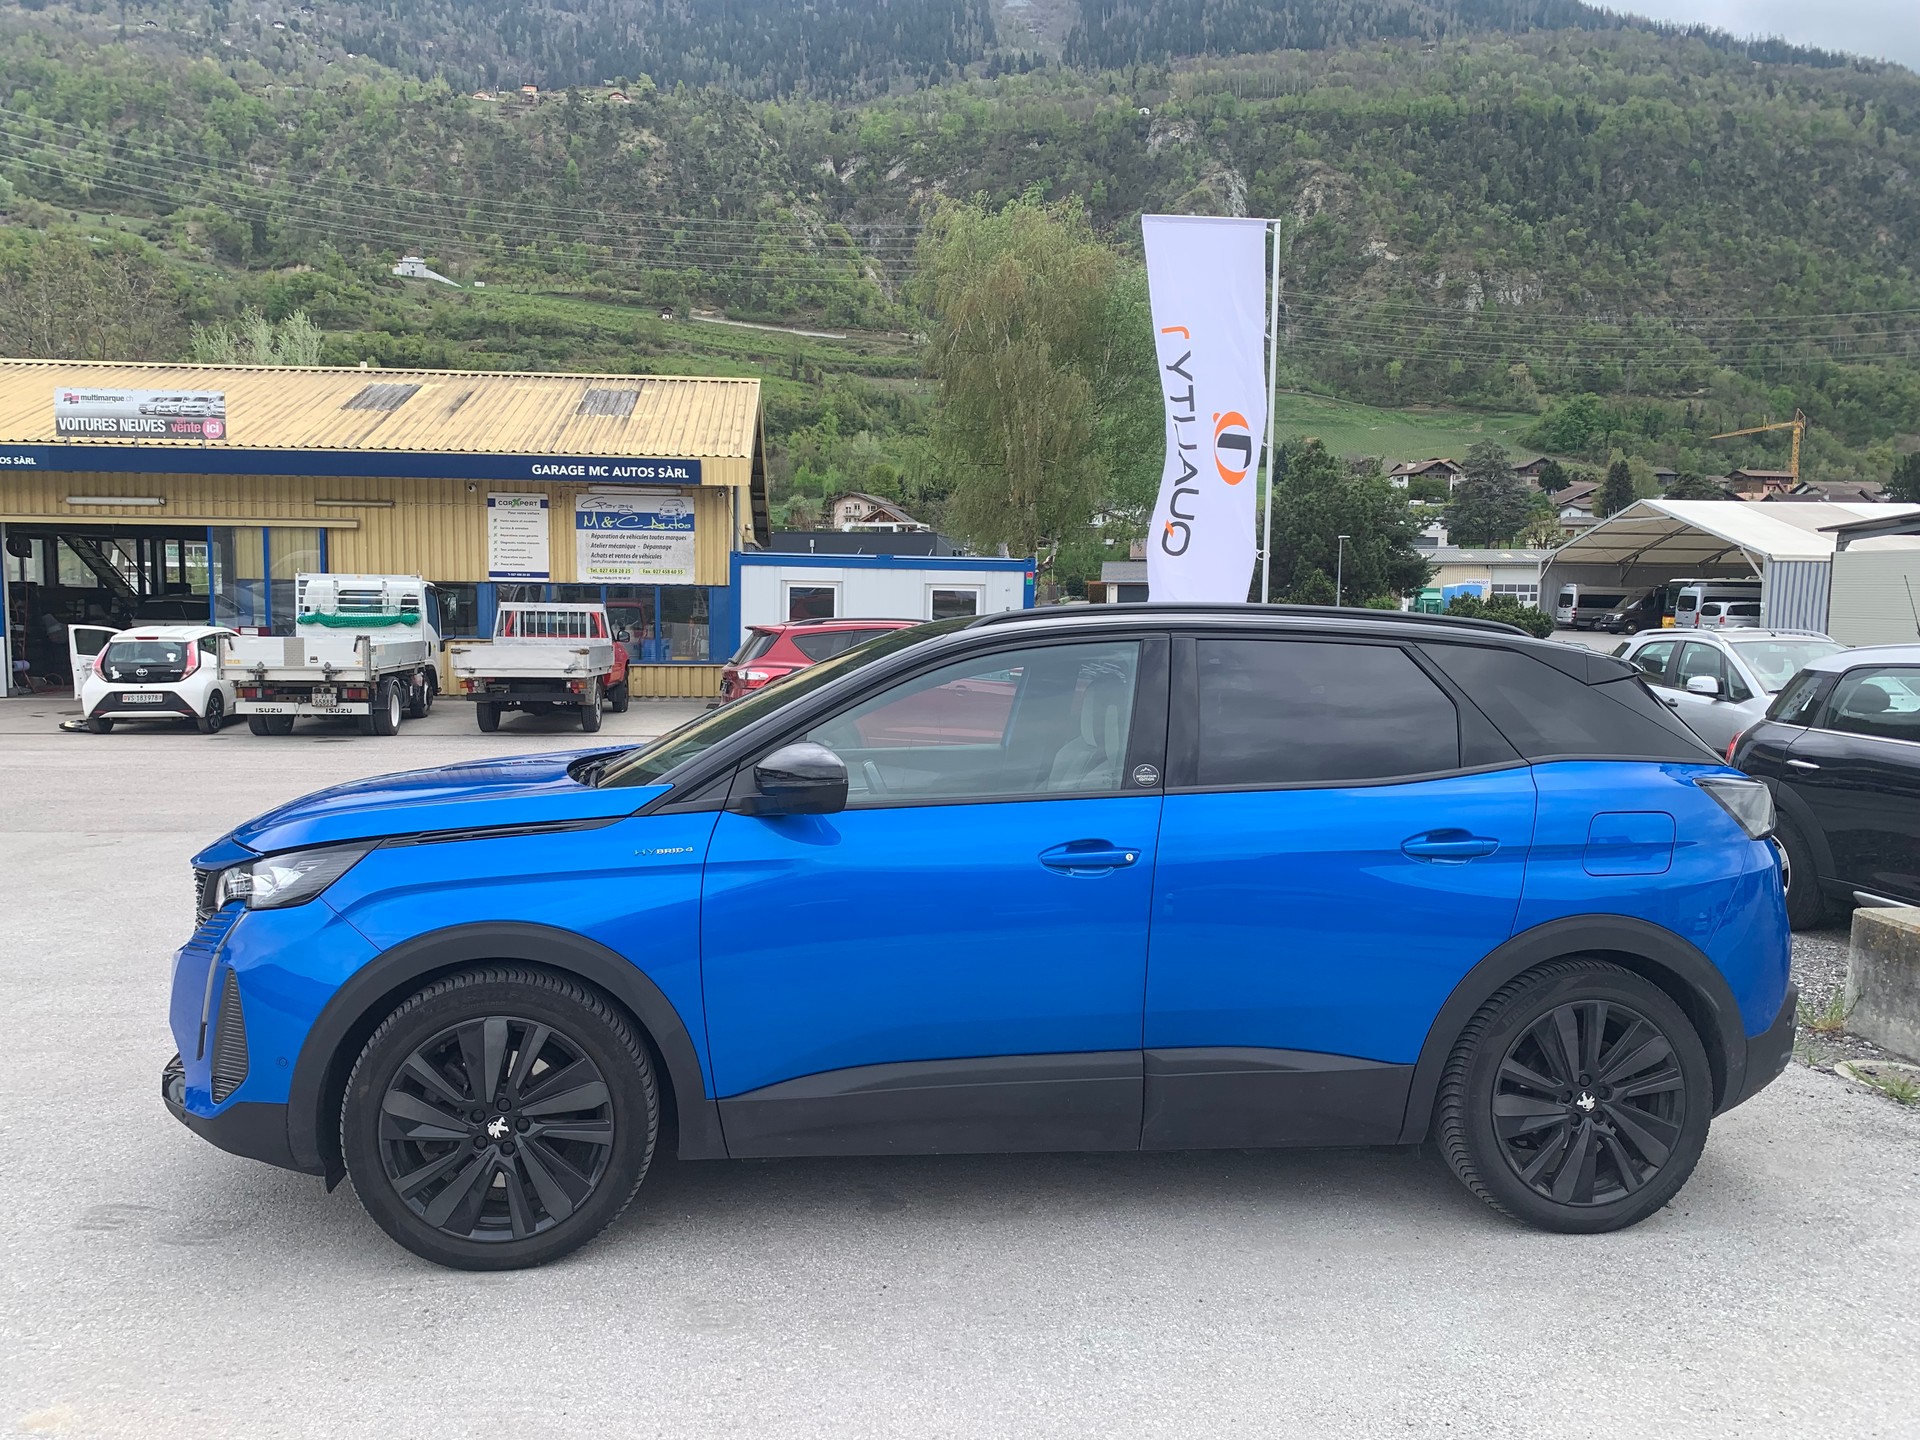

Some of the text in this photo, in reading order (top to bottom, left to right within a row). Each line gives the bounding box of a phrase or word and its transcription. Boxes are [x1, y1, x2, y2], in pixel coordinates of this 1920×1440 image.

[58, 417, 166, 432] VOITURES NEUVES
[170, 421, 219, 433] vente ici
[531, 464, 690, 478] GARAGE MC AUTOS SÀRL
[583, 511, 599, 530] M
